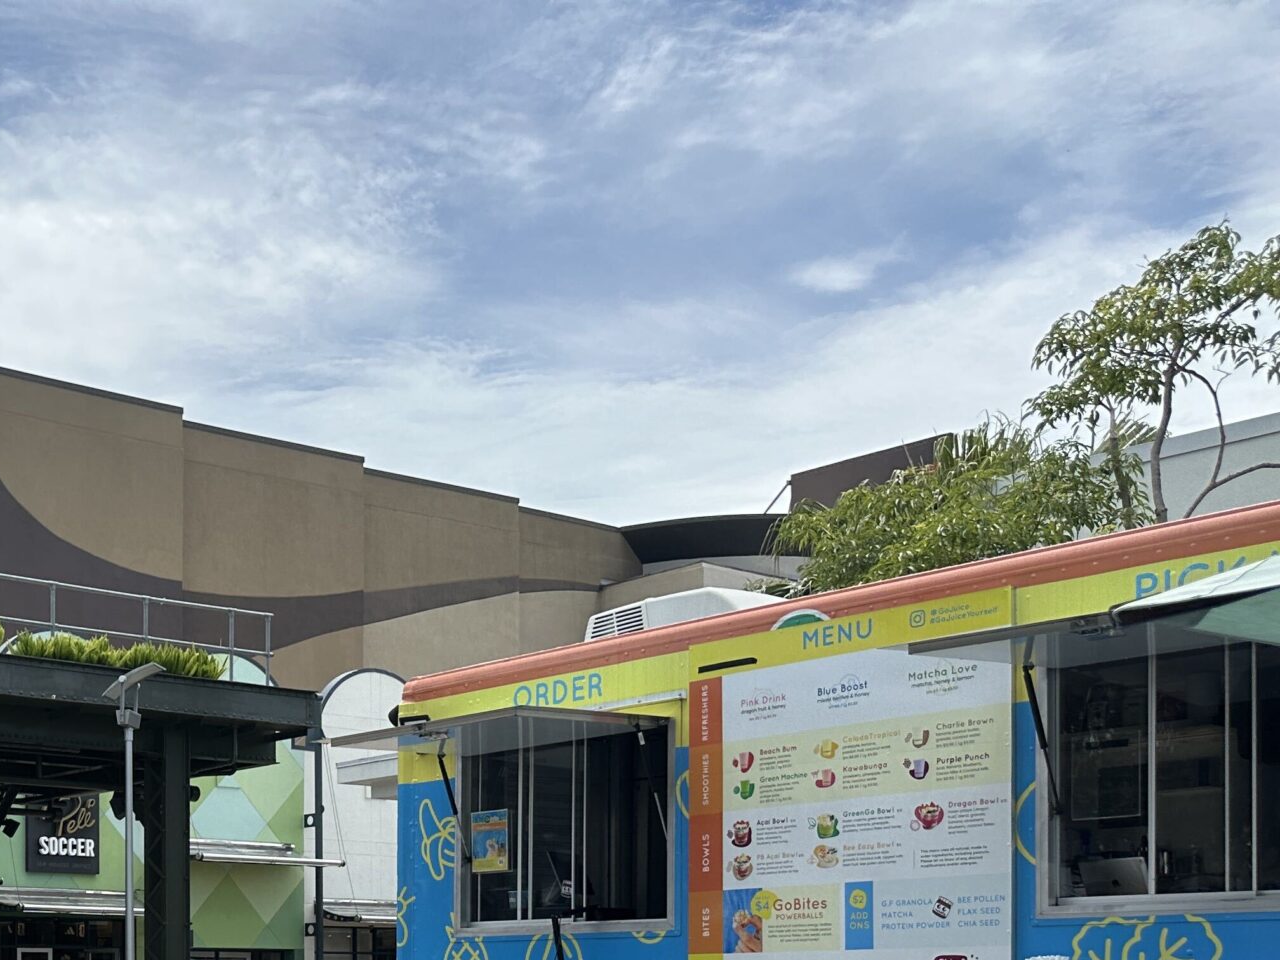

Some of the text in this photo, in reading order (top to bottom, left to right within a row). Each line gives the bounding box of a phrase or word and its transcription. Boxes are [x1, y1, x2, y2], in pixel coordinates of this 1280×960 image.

[802, 618, 873, 650] MENU
[908, 664, 978, 681] Matcha Love
[513, 672, 603, 706] ORDER
[817, 681, 868, 697] Blue Boost
[740, 693, 786, 708] Pink Drink
[935, 717, 994, 730] Charlie Brown
[760, 745, 797, 756] Beach Bum
[936, 752, 990, 766] Purple Punch
[842, 762, 888, 773] Kawabunga
[702, 753, 710, 806] SMOOTHIES
[760, 772, 808, 783] Green Machine
[948, 800, 977, 809] Dragon
[979, 797, 999, 806] Bowl
[877, 806, 895, 815] Bowl
[772, 817, 789, 825] Bowl
[39, 836, 95, 857] SOCCER
[876, 841, 895, 849] Bowl
[702, 833, 710, 873] BOWLS
[852, 895, 865, 904] $2
[895, 897, 933, 907] GRANOLA
[957, 894, 1006, 904] BEE POLLEN
[755, 900, 769, 911] $4
[773, 897, 828, 913] GoBites
[775, 912, 824, 921] POWERBALLS
[850, 912, 869, 921] ADD
[881, 911, 913, 919] MATCHA
[957, 907, 1001, 916] FLAX SEED
[702, 907, 710, 938] BITES
[849, 921, 870, 930] ONS
[881, 921, 950, 931] PROTEIN POWDER
[957, 919, 1000, 928] CHIA SEED
